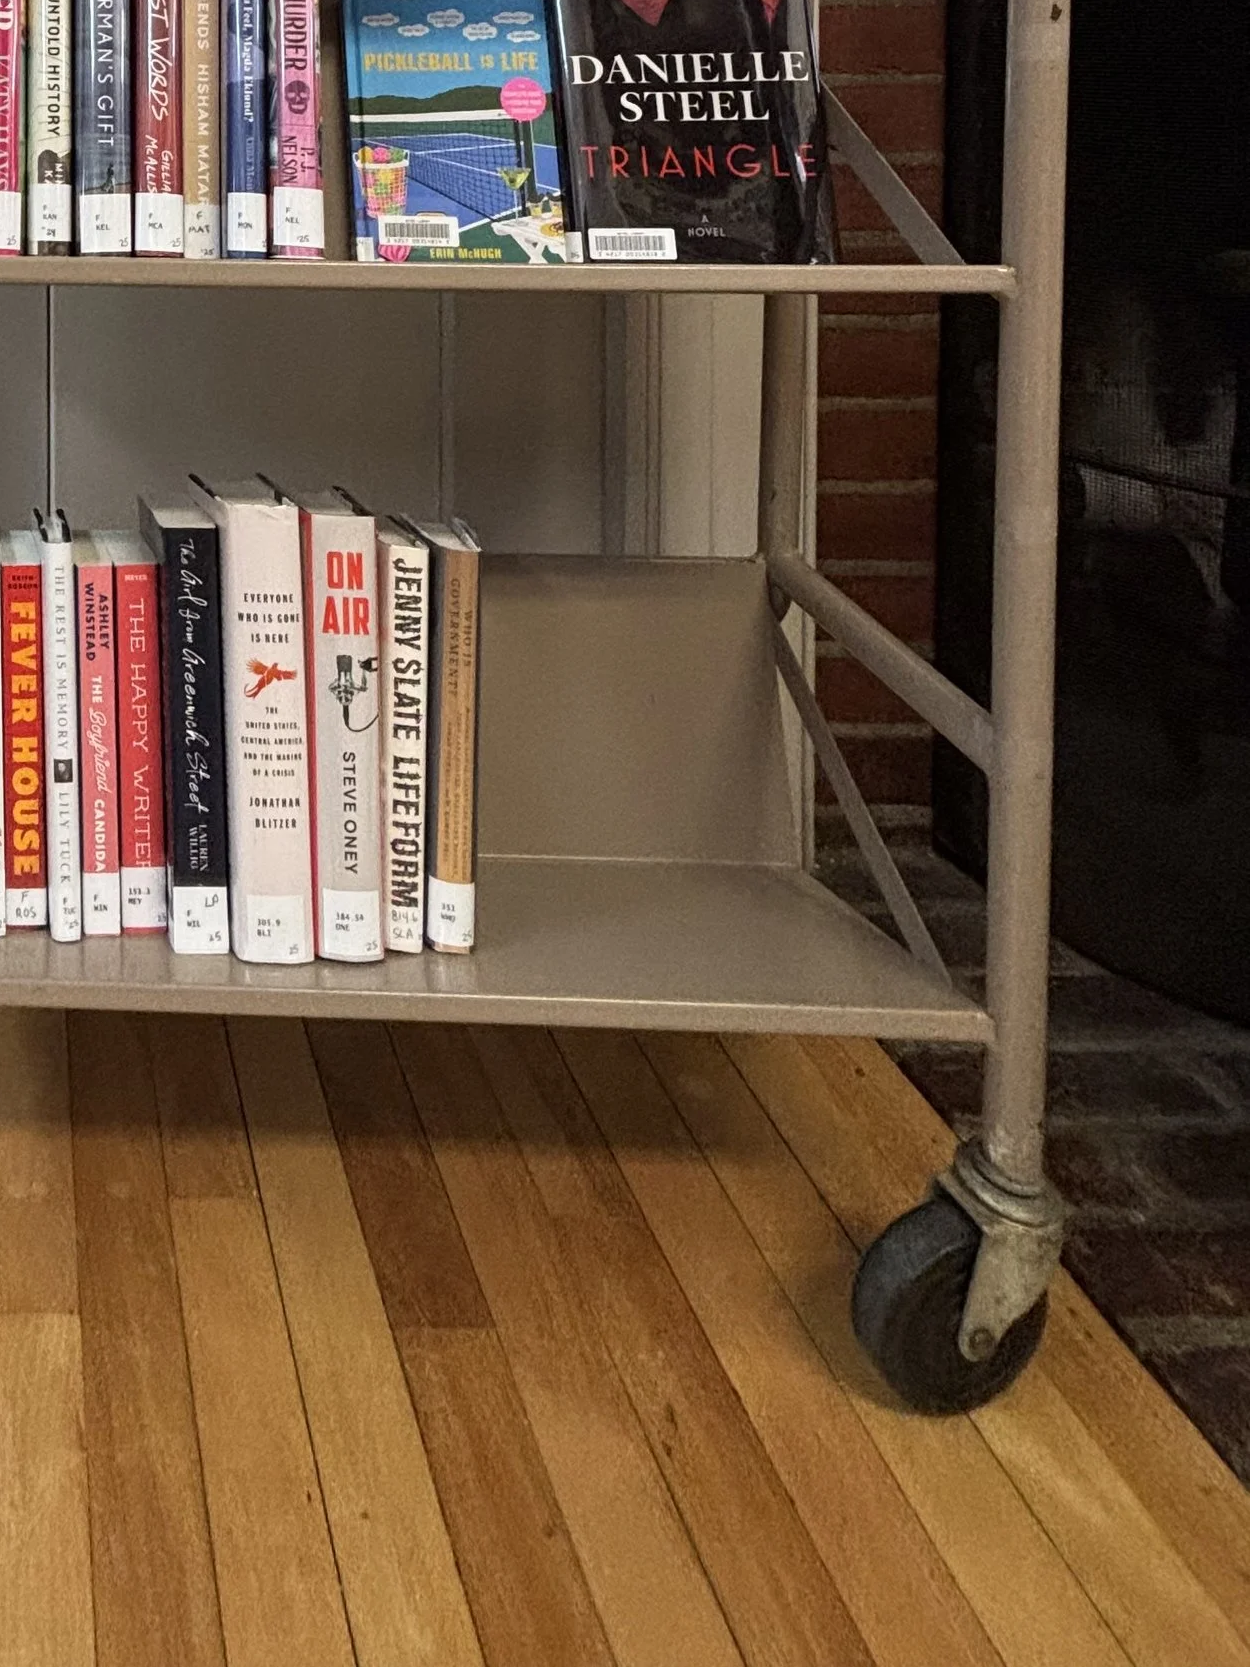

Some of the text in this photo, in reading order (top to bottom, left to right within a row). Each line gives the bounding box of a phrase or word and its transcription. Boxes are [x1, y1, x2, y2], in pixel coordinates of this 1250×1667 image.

[149, 36, 172, 122] WORDS
[363, 50, 539, 72] PICKLEBALL LIFE
[568, 51, 809, 85] DANIELLE
[47, 64, 61, 137] HISTORY
[197, 63, 210, 136] HISHAM
[243, 76, 254, 123] Eklund?
[619, 90, 769, 123] STEEL
[97, 95, 114, 146] GIFT
[282, 135, 298, 184] NELSON
[300, 147, 316, 173] P.J.
[580, 143, 817, 178] TRIANGLE
[687, 227, 726, 238] NOVEL
[429, 248, 502, 259] ERIN McHUGH
[326, 551, 364, 590] ON
[243, 593, 294, 603] EVERYONE
[322, 596, 370, 635] AIR
[84, 583, 96, 662] WINSTEAD
[99, 594, 110, 650] ASHLEY
[238, 613, 300, 623] WHO GONE
[264, 634, 289, 643] HERE
[54, 567, 68, 755] THE REST IS MEMORY
[129, 598, 148, 753] THE HAPPY
[178, 538, 210, 814] The Girl from Greenwich Street
[10, 601, 40, 876] FEVER HOUSE
[88, 675, 111, 794] THE Boyfriend
[241, 737, 270, 745] CENTRAL
[245, 721, 271, 729] UNITED
[390, 557, 424, 908] JENNY SLATE LIFEFORM
[272, 769, 295, 777] CRISIS
[249, 797, 300, 807] JONATHAN
[343, 751, 358, 875] STEVE ONEY
[58, 792, 71, 883] LILY TUCK
[255, 818, 297, 828] BLITZER
[15, 907, 36, 918] ROS
[187, 920, 201, 928] WIL
